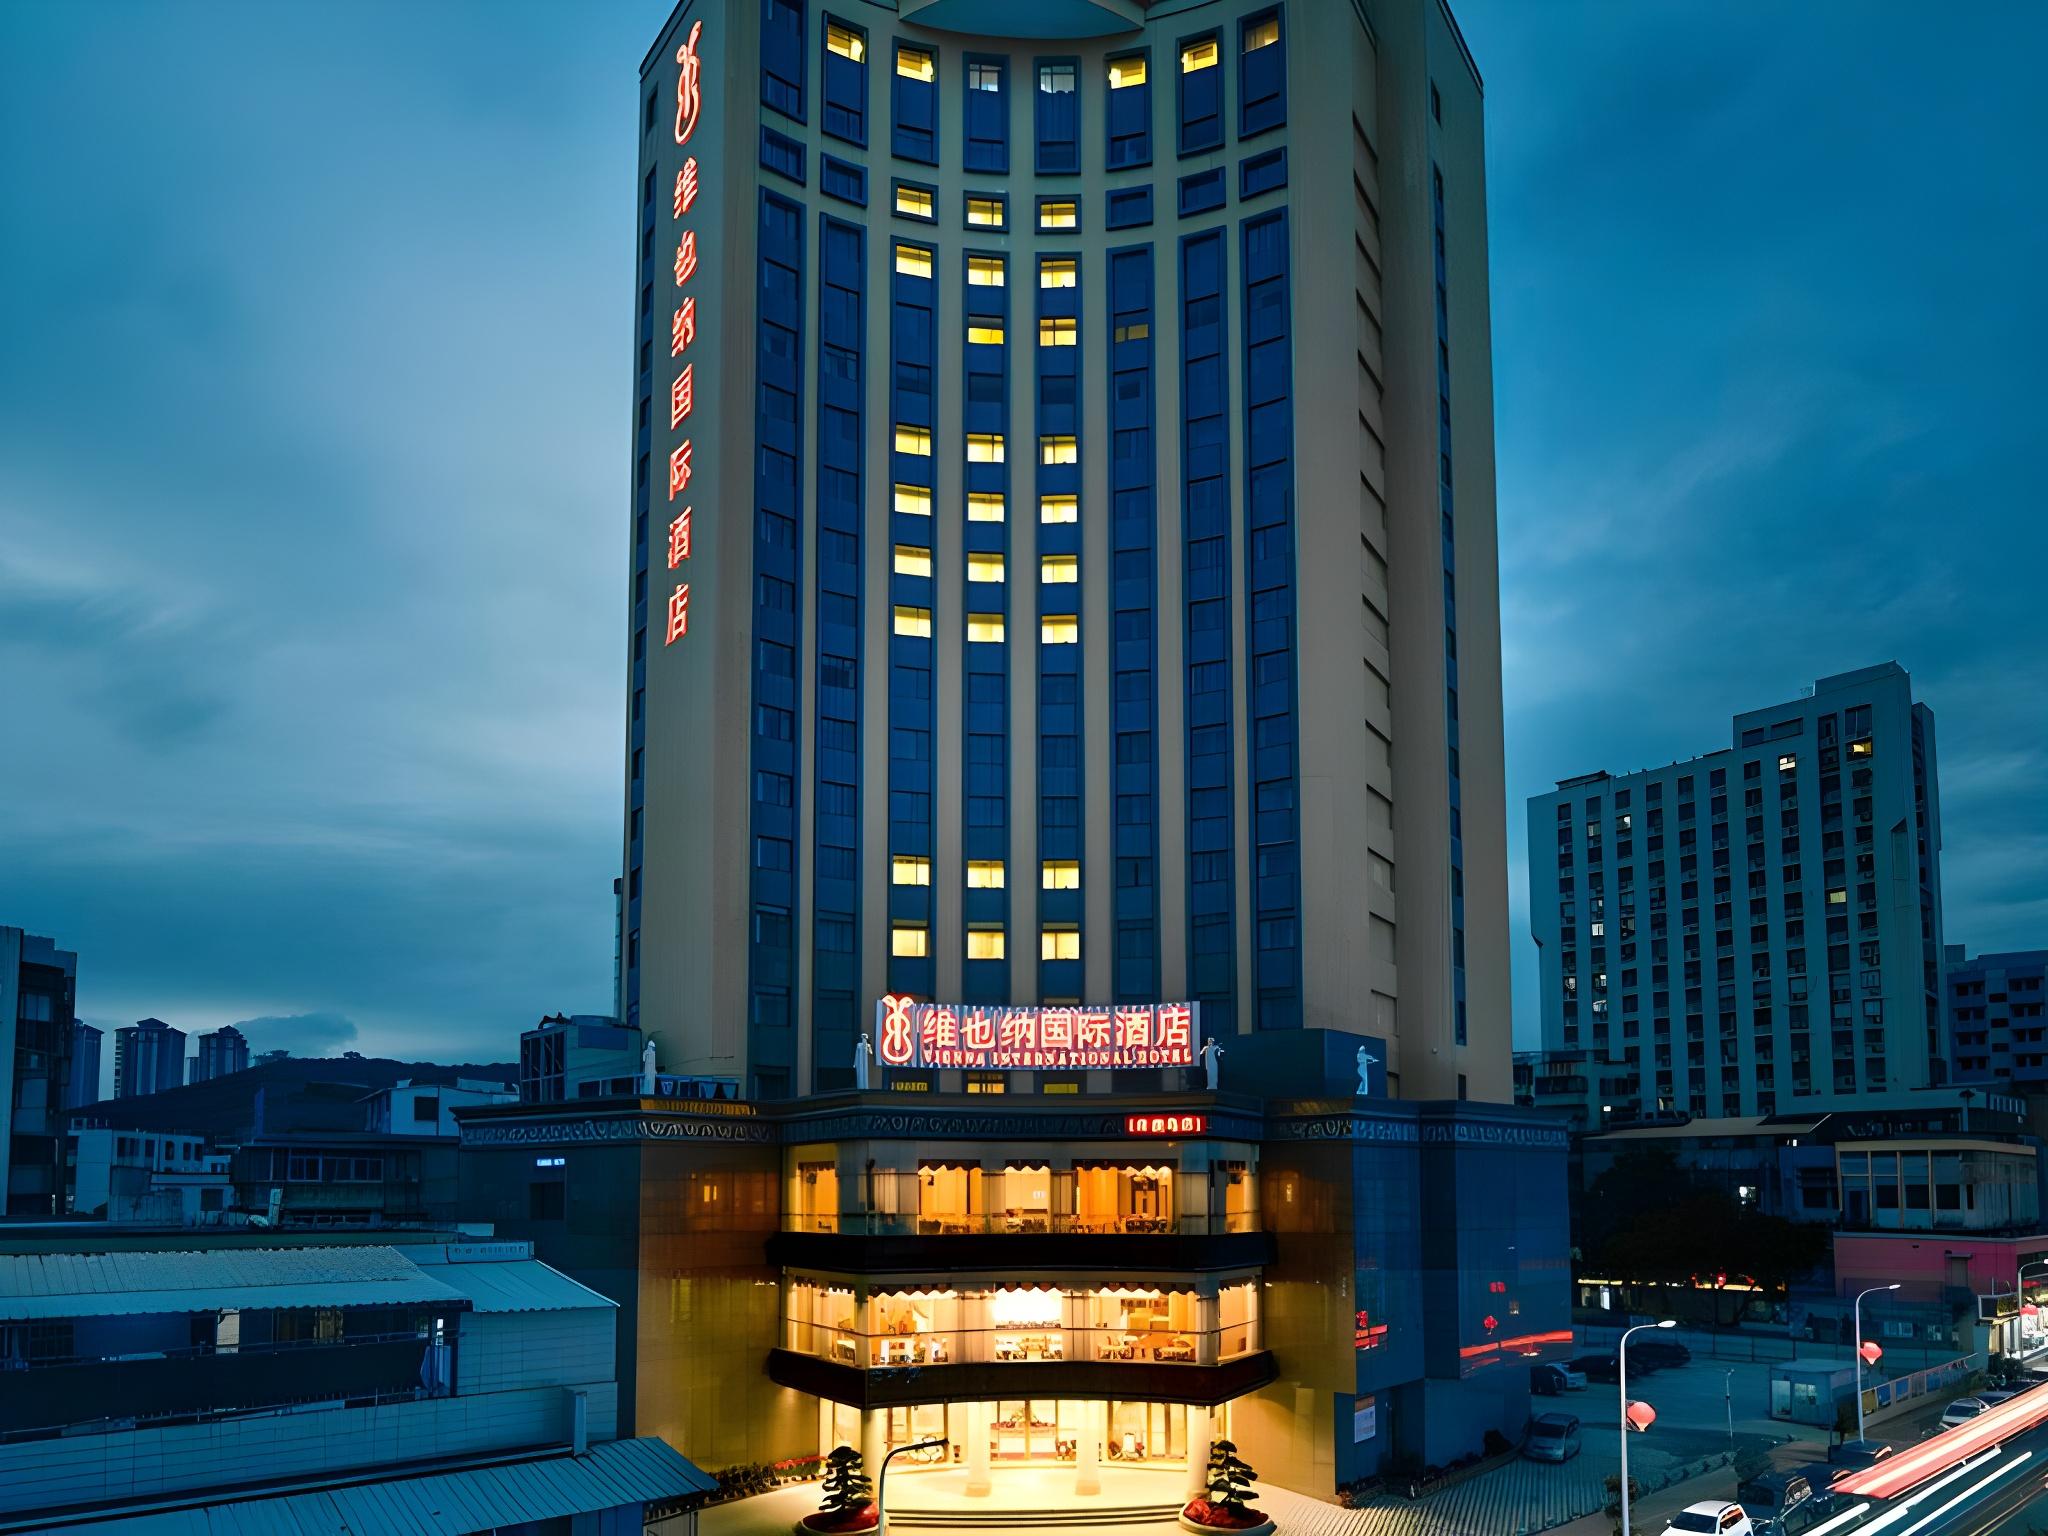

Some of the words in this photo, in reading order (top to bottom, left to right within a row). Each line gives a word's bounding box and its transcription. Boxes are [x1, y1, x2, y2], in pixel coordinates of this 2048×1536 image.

[665, 157, 697, 646] 维也纳国际酒店
[923, 1008, 1190, 1049] 维也纳国际酒店
